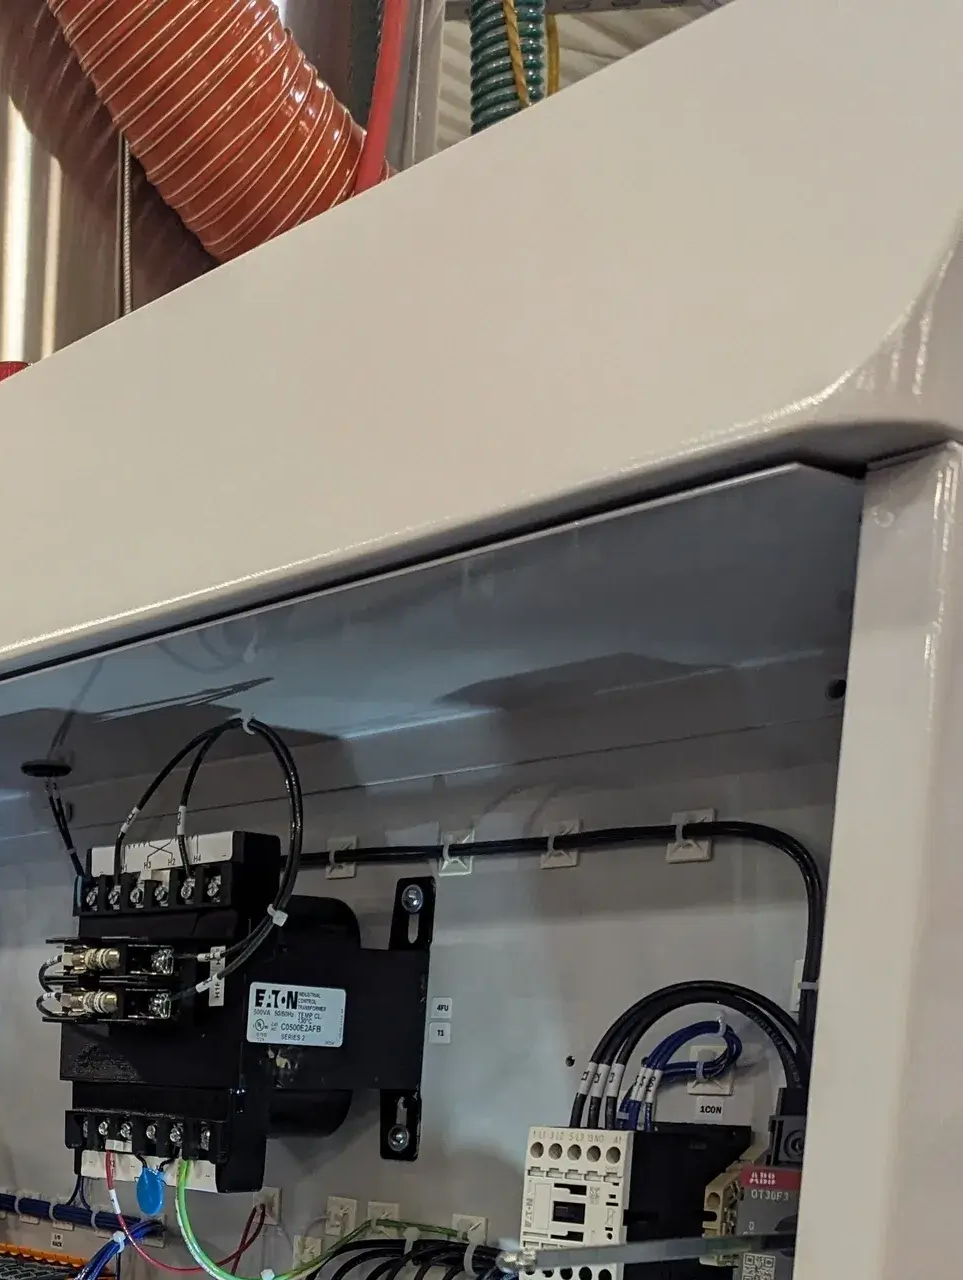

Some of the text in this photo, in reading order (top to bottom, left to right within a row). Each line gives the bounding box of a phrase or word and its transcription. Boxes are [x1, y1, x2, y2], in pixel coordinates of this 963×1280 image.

[255, 988, 299, 1010] EATON
[298, 1004, 326, 1012] TRANSFORMER
[436, 1004, 449, 1012] 4FU
[280, 1022, 322, 1033] C0500E2AFB
[437, 1029, 445, 1037] T1
[700, 1105, 722, 1114] 1CON
[749, 1172, 776, 1185] ABB
